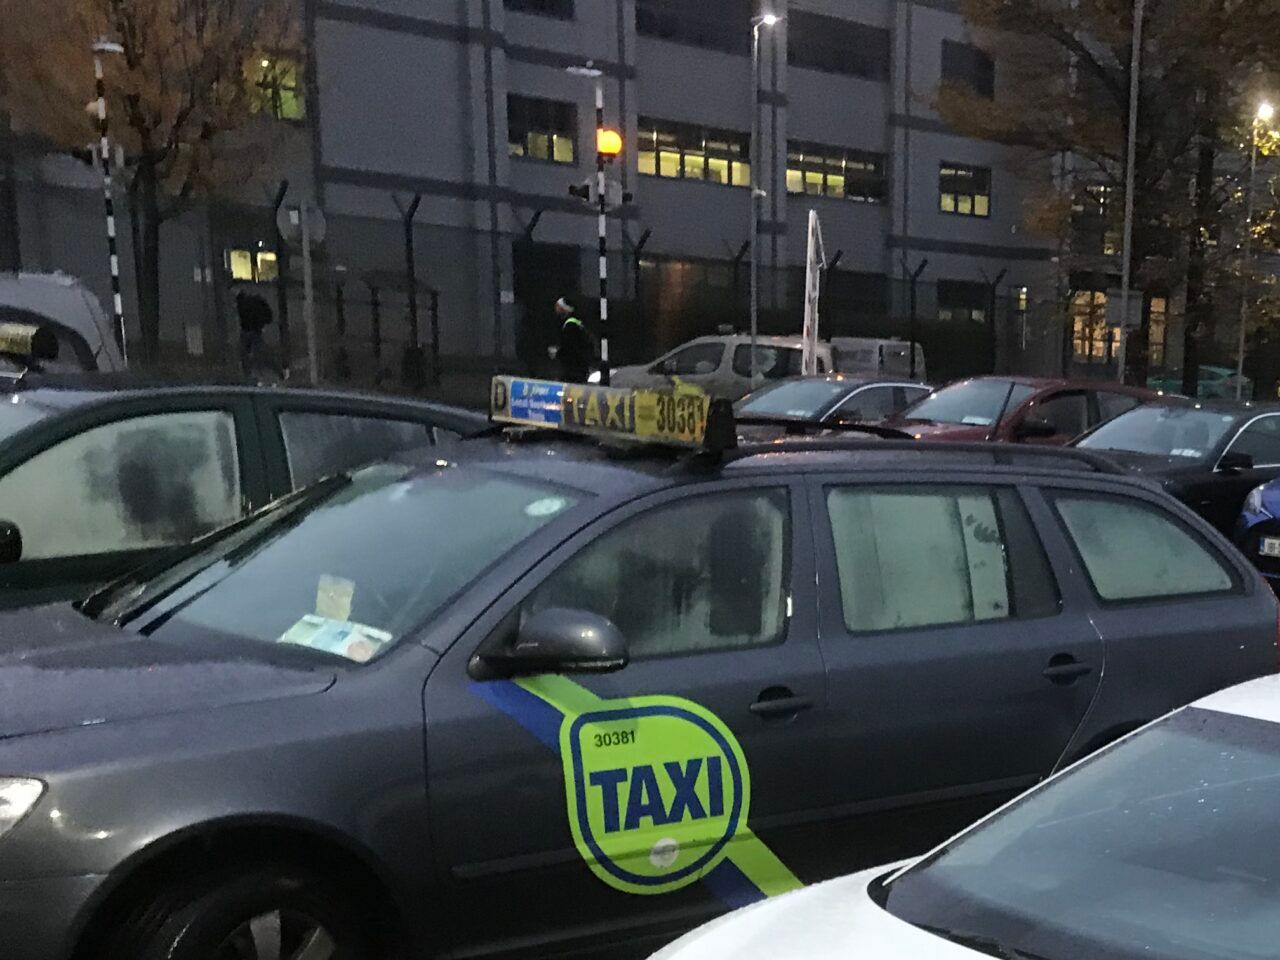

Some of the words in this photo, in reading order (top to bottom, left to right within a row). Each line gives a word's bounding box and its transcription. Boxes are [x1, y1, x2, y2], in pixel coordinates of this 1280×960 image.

[569, 386, 635, 432] TAXI
[657, 393, 704, 435] 30381
[593, 730, 636, 748] 30381
[589, 755, 725, 834] TAXI
